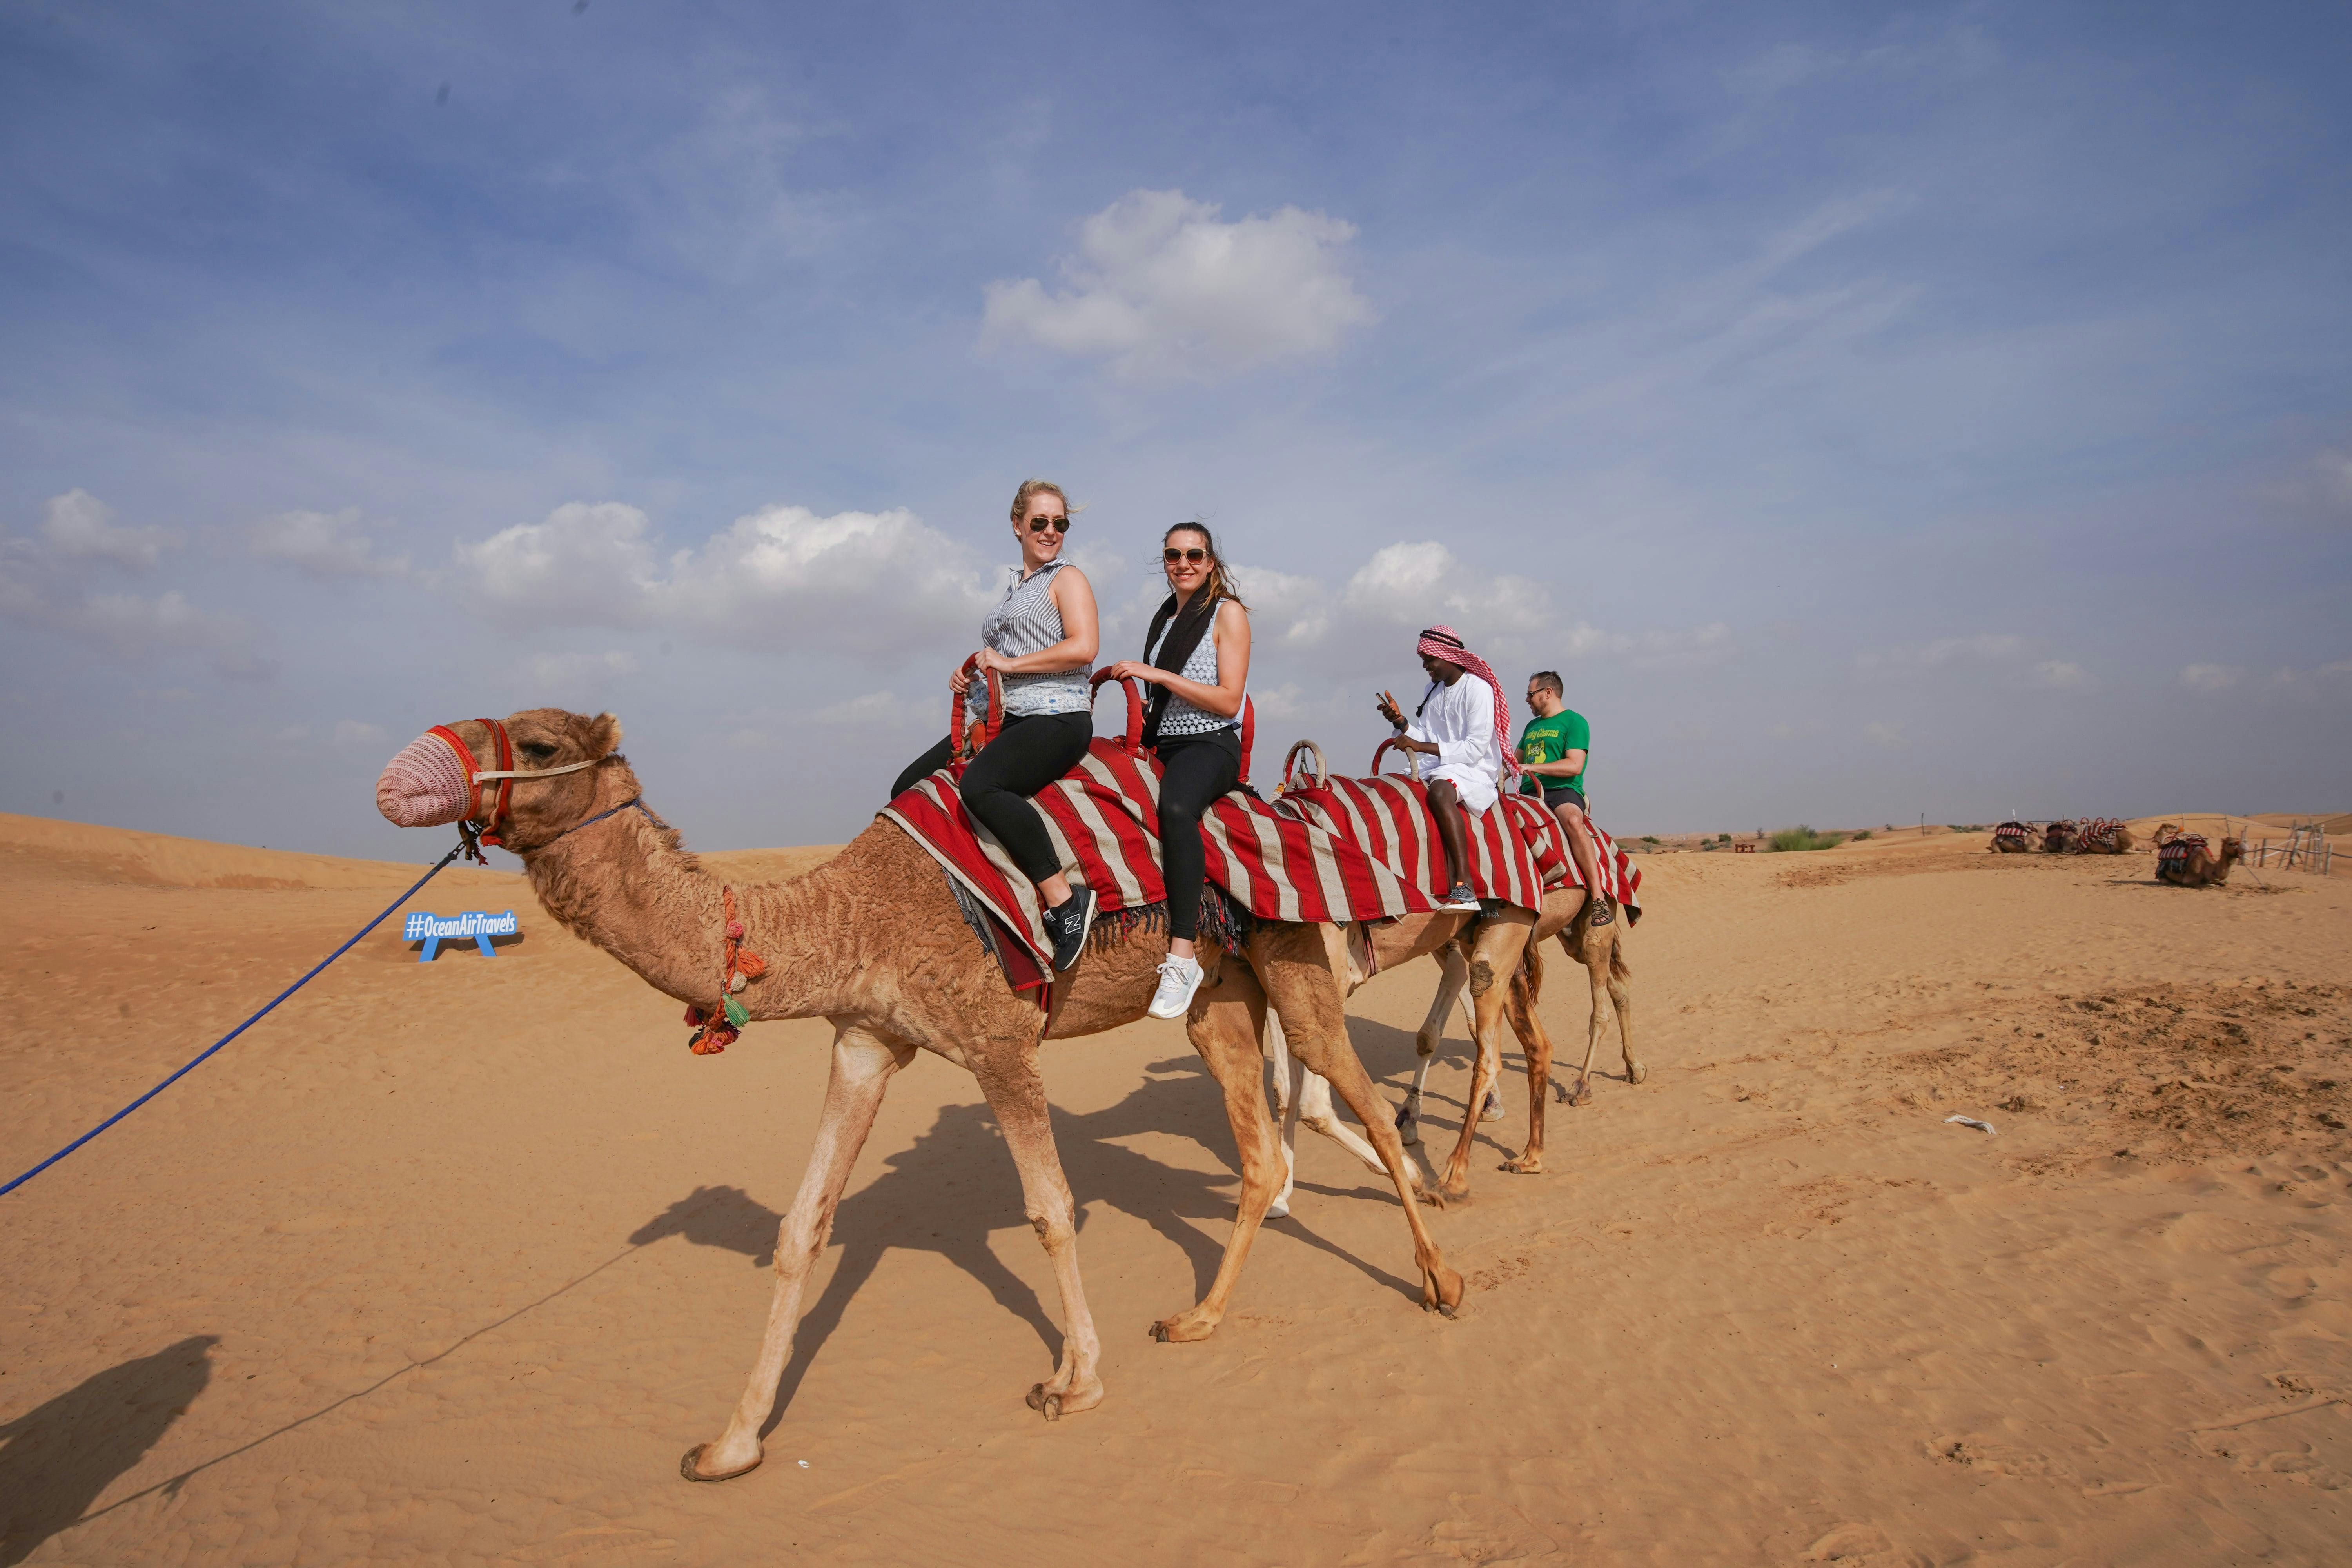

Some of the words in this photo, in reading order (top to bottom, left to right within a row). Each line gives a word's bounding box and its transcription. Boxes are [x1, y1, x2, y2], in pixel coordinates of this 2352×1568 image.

[1537, 728, 1559, 737] Charms
[406, 912, 515, 938] #OceanAirTravels
[1065, 913, 1081, 935] N
